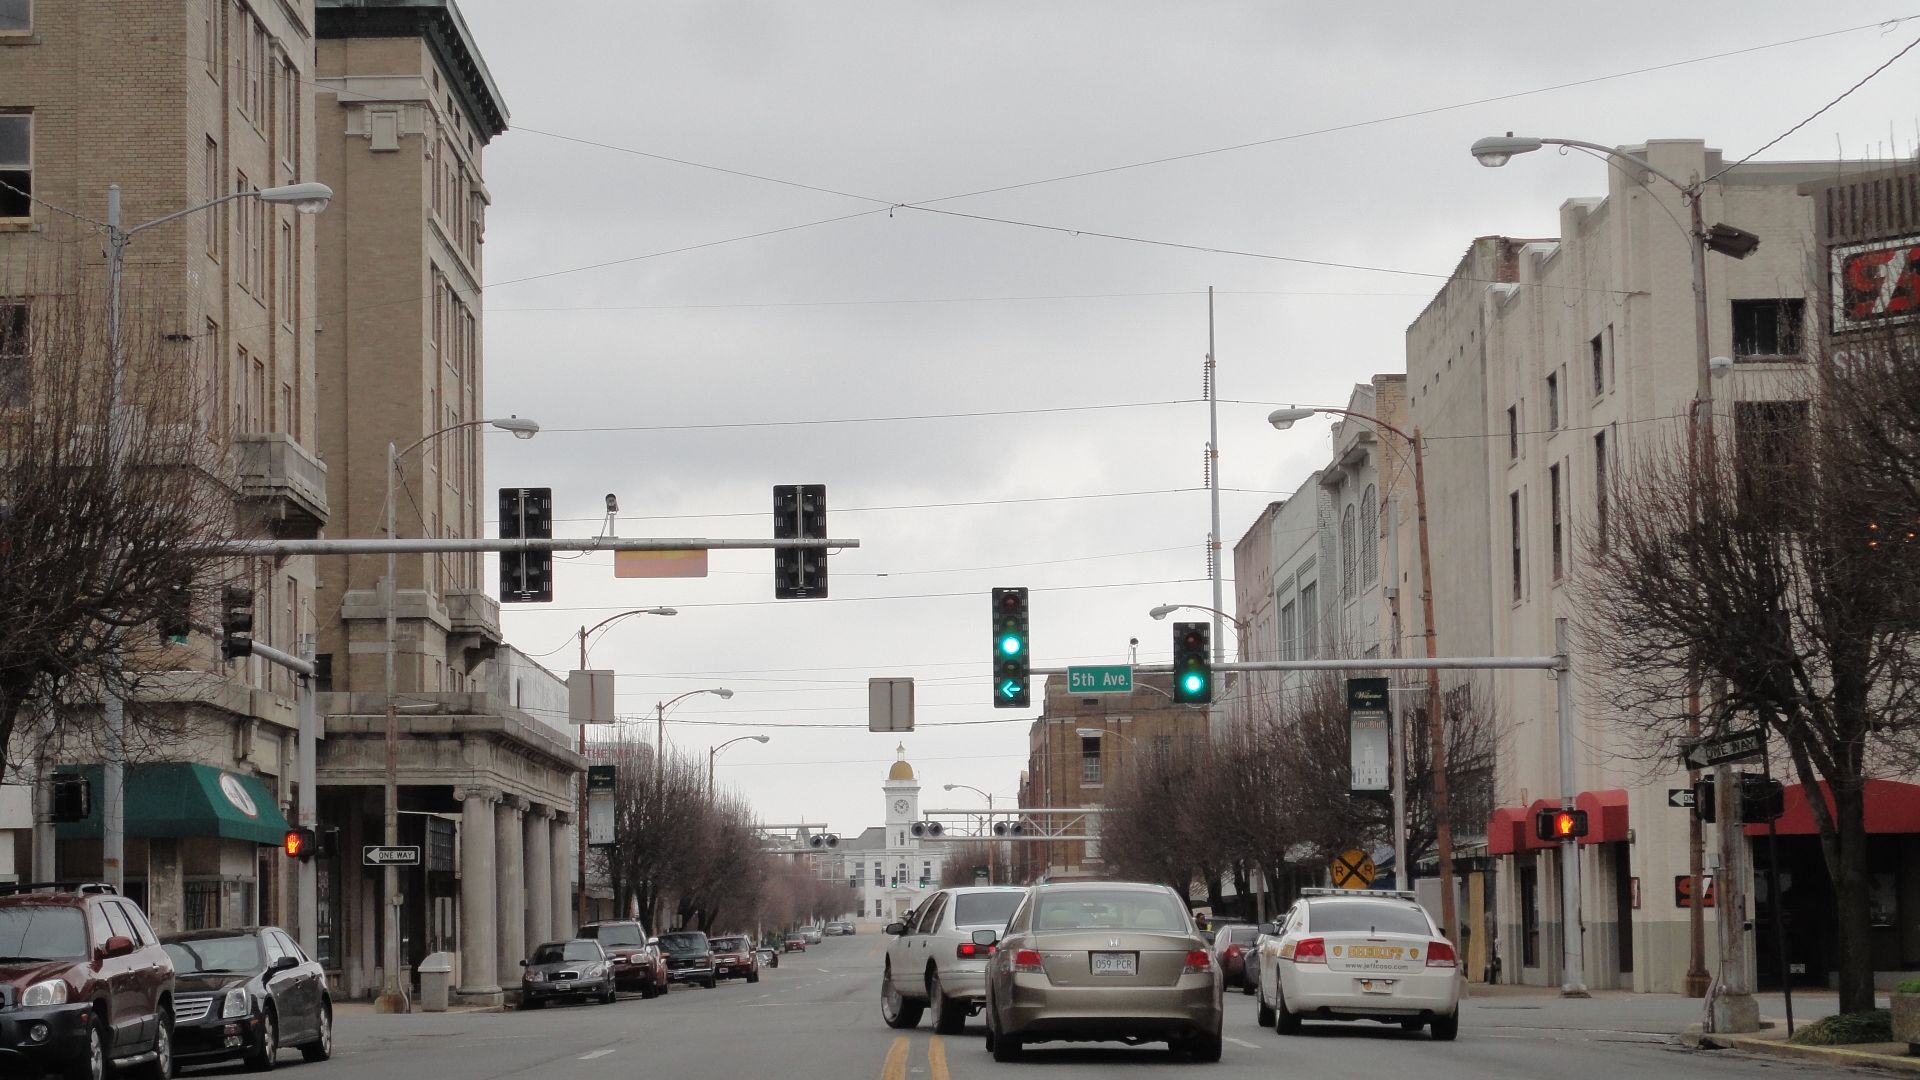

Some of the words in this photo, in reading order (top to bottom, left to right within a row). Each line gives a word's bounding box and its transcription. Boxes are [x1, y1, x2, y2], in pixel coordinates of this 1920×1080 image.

[1072, 673, 1095, 687] 5th
[1103, 672, 1129, 686] Ave.
[1705, 743, 1728, 758] ONE
[1731, 736, 1755, 754] WAY
[397, 851, 413, 859] WAY
[1335, 866, 1344, 876] R
[1096, 960, 1111, 968] 059
[1116, 960, 1132, 969] PCR
